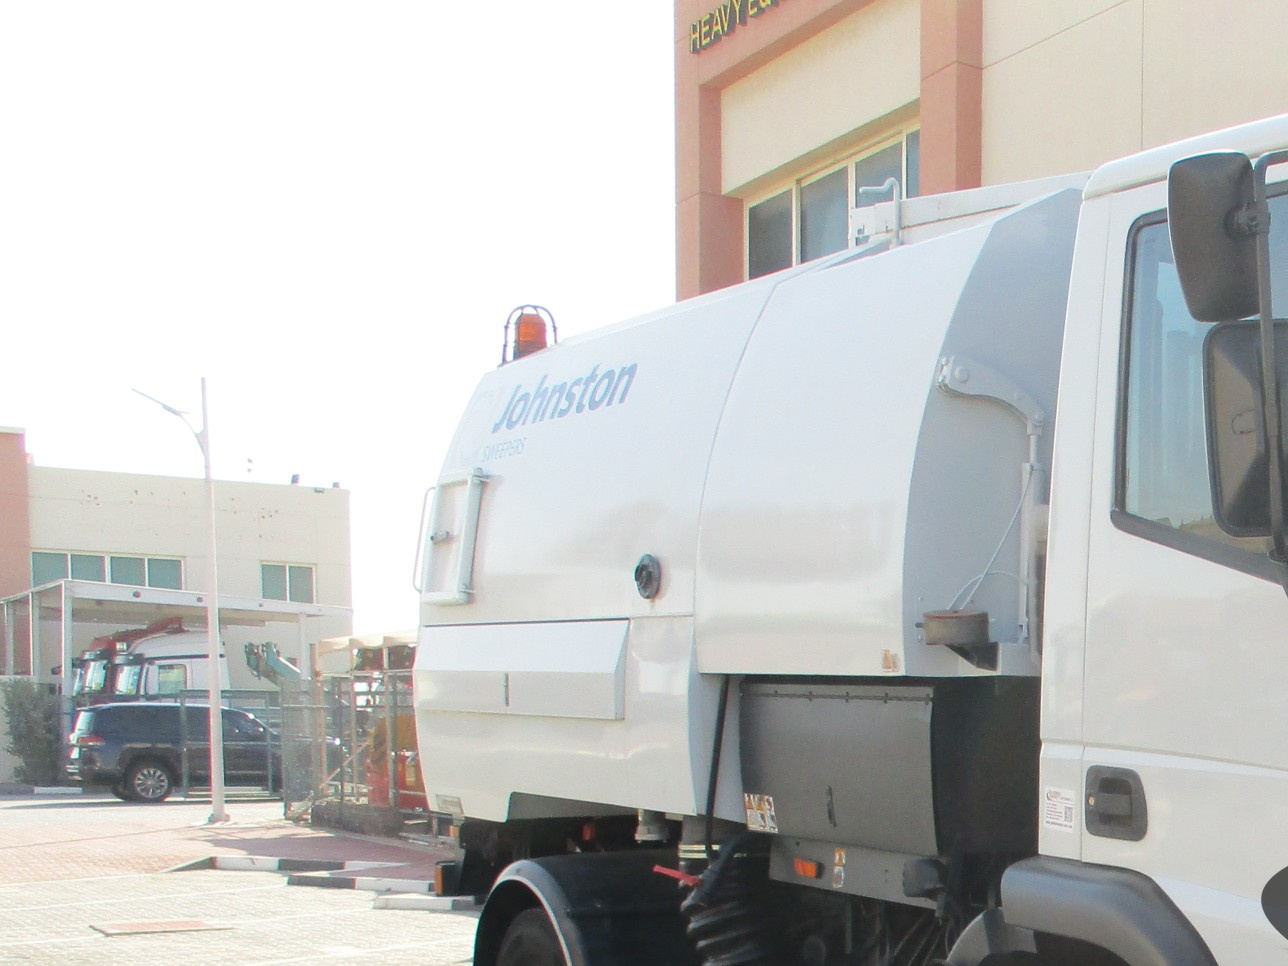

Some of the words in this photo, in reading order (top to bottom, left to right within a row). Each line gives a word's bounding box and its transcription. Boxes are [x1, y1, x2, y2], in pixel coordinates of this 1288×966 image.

[690, 0, 742, 53] HEAVY
[491, 363, 638, 434] Johnston
[480, 437, 527, 462] SWEEPERS
